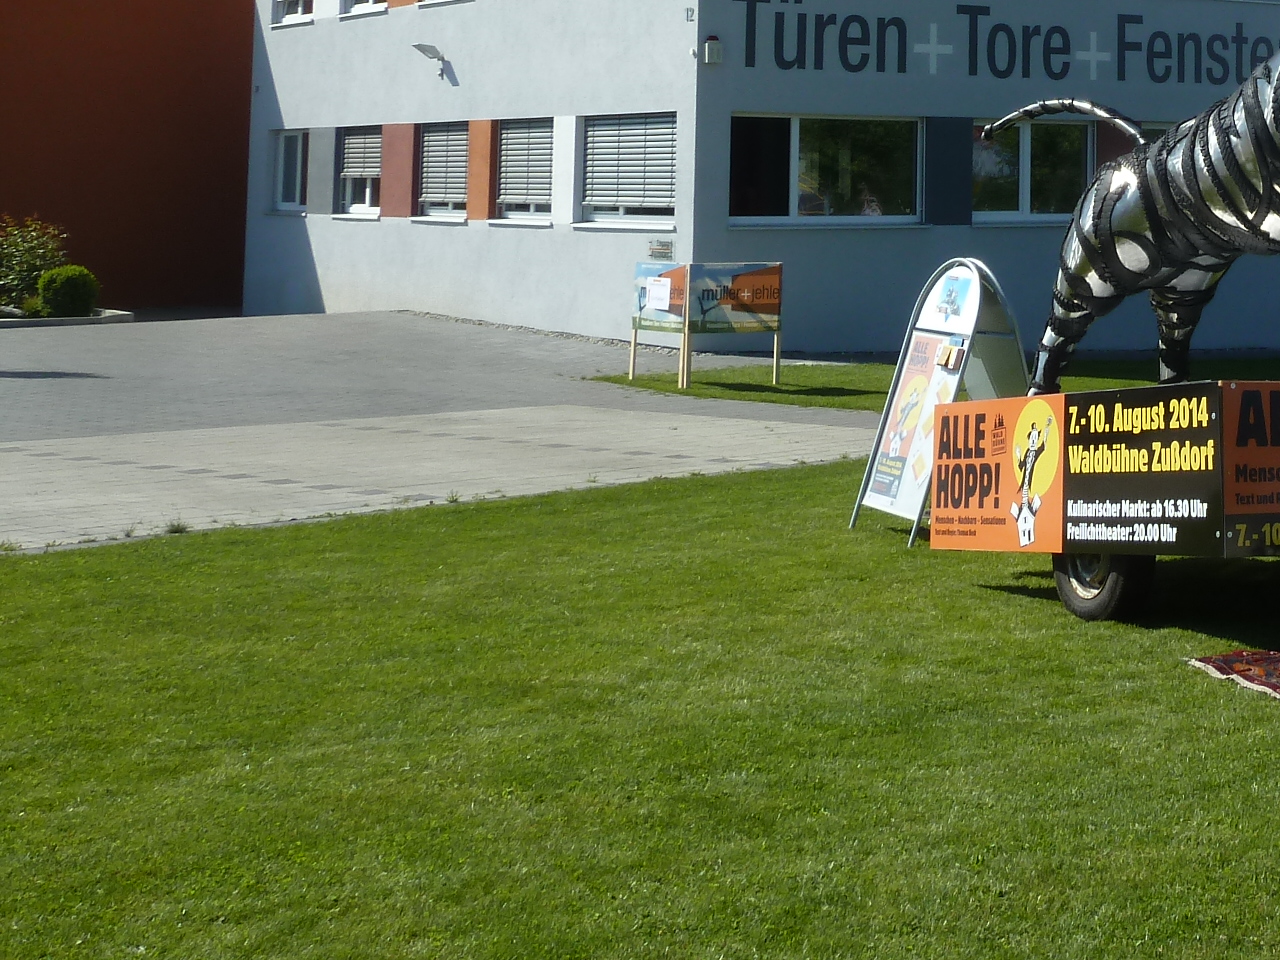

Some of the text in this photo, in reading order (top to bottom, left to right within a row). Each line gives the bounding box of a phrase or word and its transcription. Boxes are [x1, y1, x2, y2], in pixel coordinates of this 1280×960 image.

[1112, 401, 1166, 436] August
[1169, 396, 1209, 430] 2014
[938, 413, 986, 460] ALLE
[1068, 439, 1214, 474] Waldbühne Zußdorf
[936, 462, 1001, 509] HOPP!
[1235, 492, 1254, 506] Text
[1254, 492, 1275, 505] und
[1067, 498, 1208, 519] Kulinarischer Markt: ab 16.30 Uhr
[1133, 522, 1159, 541] 20.00
[1159, 523, 1178, 541] Uhr
